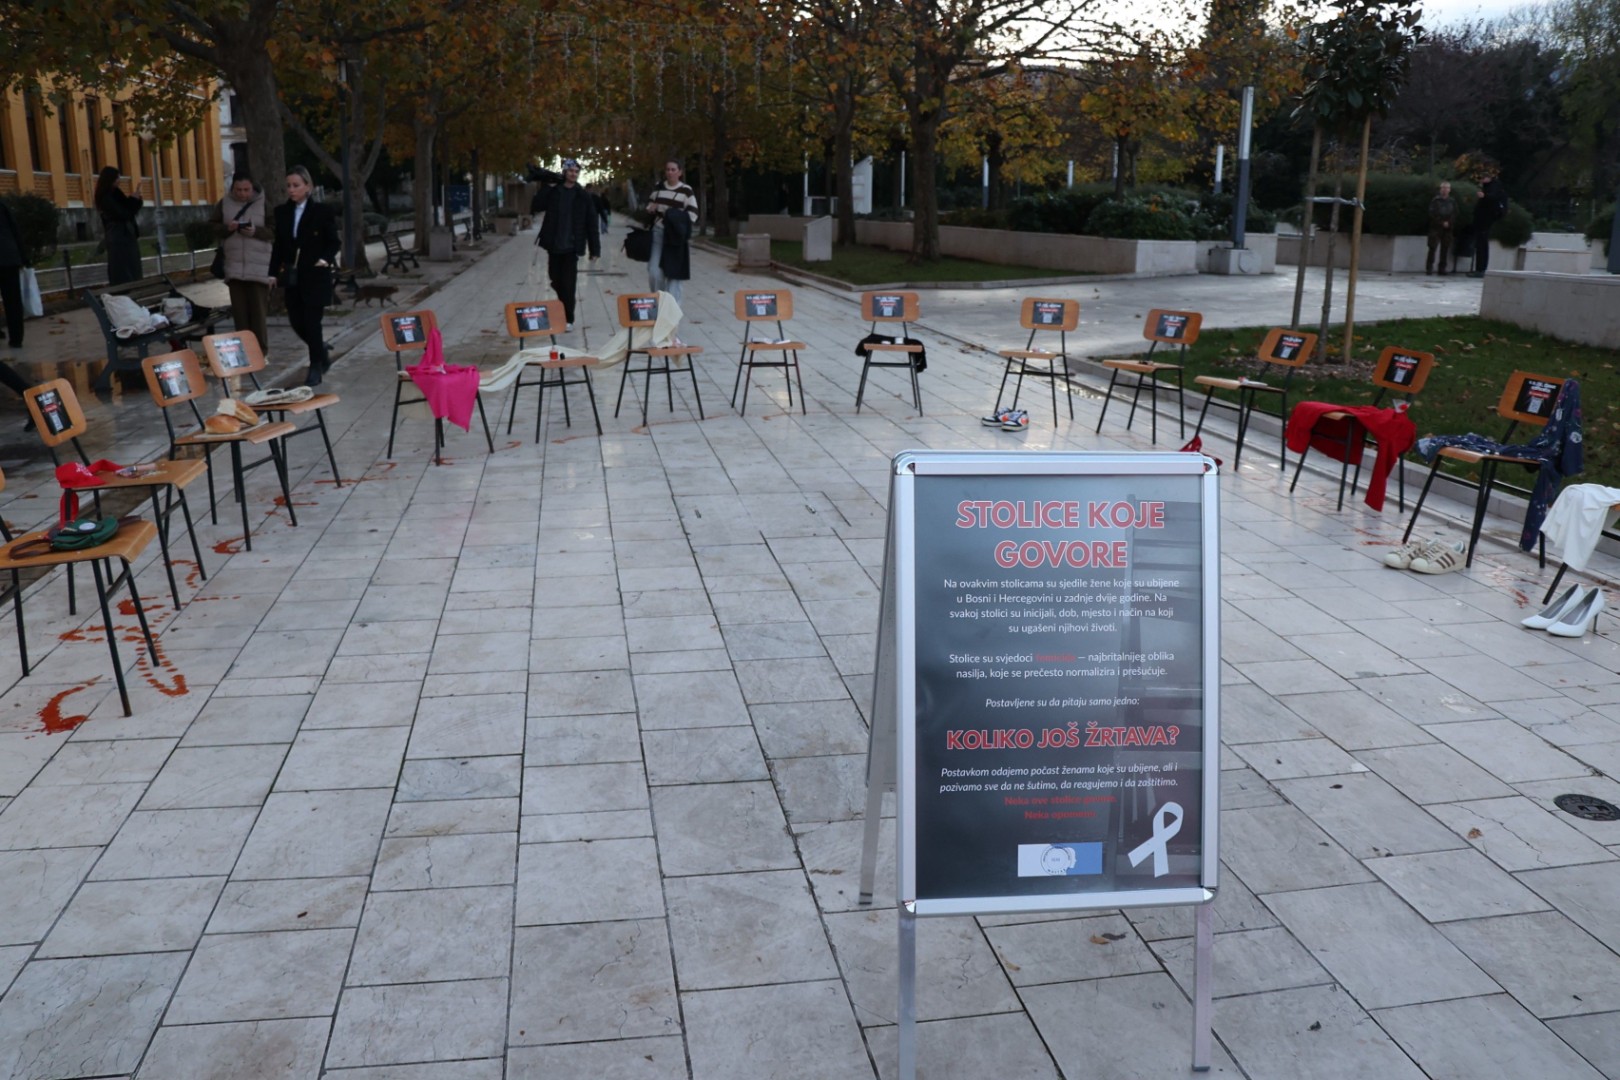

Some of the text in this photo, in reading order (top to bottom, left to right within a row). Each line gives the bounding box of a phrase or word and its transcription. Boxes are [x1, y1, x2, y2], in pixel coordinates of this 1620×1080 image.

[956, 501, 1164, 529] STOLICE KOJE
[994, 540, 1127, 568] GOVORE
[944, 580, 956, 588] Na
[960, 579, 998, 588] ovakvim
[1000, 579, 1043, 588] stolicama
[1059, 579, 1087, 590] sjedile
[1090, 578, 1110, 588] žene
[1113, 579, 1131, 590] koje
[1147, 578, 1179, 590] ubijene
[966, 594, 991, 603] Bosni
[999, 593, 1053, 605] Hercegovini
[1064, 593, 1093, 604] zadnje
[1096, 593, 1117, 604] dvije
[1120, 593, 1151, 604] godine.
[1155, 593, 1167, 602] Na
[950, 609, 978, 620] svakoj
[981, 609, 1008, 618] stolici
[1023, 608, 1056, 620] inicijali,
[1059, 608, 1079, 619] dob,
[1081, 608, 1111, 619] mjesto
[1120, 608, 1142, 617] način
[1158, 608, 1173, 619] koji
[1022, 623, 1056, 634] ugašeni
[1059, 623, 1088, 634] njihovi
[1091, 623, 1117, 632] životi.
[950, 654, 980, 663] Stolice
[996, 653, 1032, 664] svjedoci
[1088, 652, 1145, 664] najbritalnijeg
[1148, 652, 1174, 661] oblika
[957, 669, 987, 680] nasilja,
[990, 668, 1009, 680] koje
[1024, 668, 1063, 679] prečesto
[1066, 668, 1115, 677] normalizira
[986, 698, 1035, 709] Postavljene
[1050, 698, 1060, 707] da
[1062, 698, 1087, 708] pitaju
[1114, 697, 1140, 707] jedno:
[947, 721, 1180, 750] KOLIKO JOŠ ŽRTAVA?
[941, 768, 989, 778] Postavkom
[992, 766, 1029, 777] odajemo
[1031, 766, 1059, 777] počast
[1062, 765, 1095, 775] ženama
[1097, 764, 1114, 775] koje
[1128, 763, 1160, 775] ubijene,
[1163, 763, 1173, 772] ali
[940, 782, 982, 794] pozivamo
[1001, 781, 1011, 790] da
[1027, 781, 1058, 791] šutimo,
[1061, 780, 1071, 789] da
[1074, 779, 1118, 790] reagujemo
[1125, 778, 1135, 787] da
[1138, 778, 1178, 787] zaštitimo.
[1005, 796, 1029, 805] Neka
